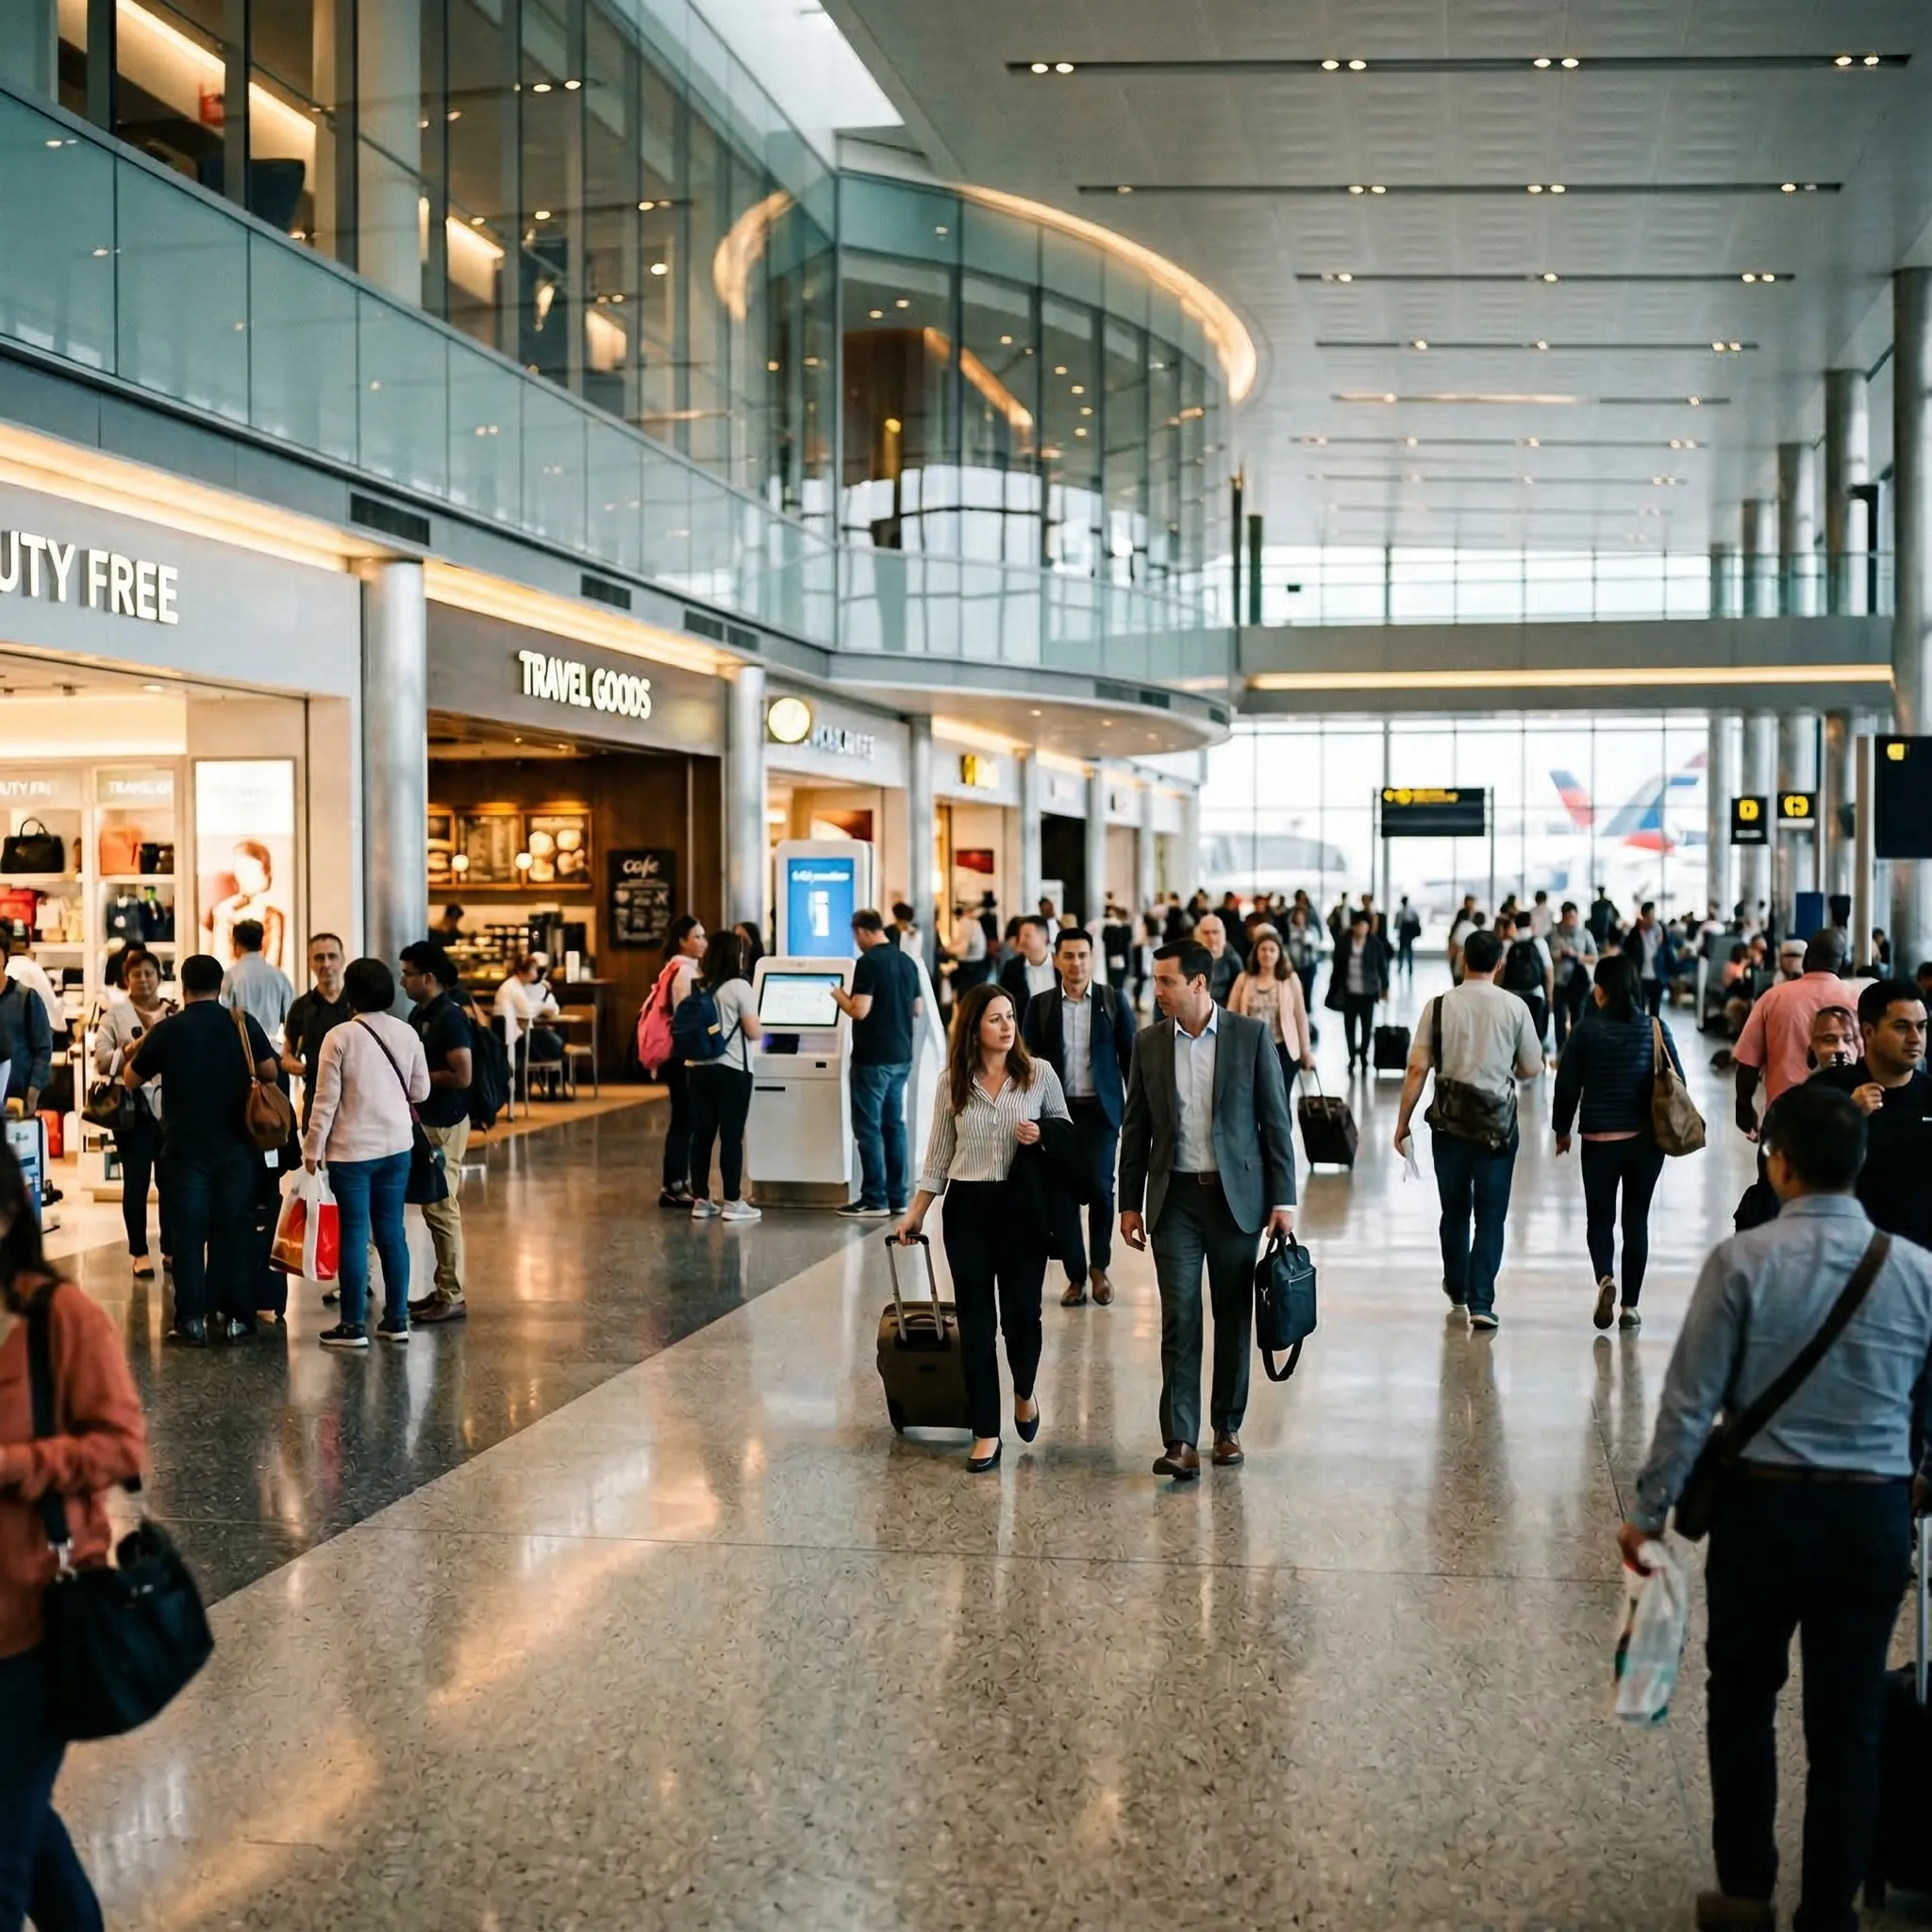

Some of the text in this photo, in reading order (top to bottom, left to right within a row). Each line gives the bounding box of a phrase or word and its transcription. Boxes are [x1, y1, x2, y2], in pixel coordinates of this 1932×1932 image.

[89, 548, 179, 625] FREE
[519, 650, 652, 720] TRAVEL GOODS
